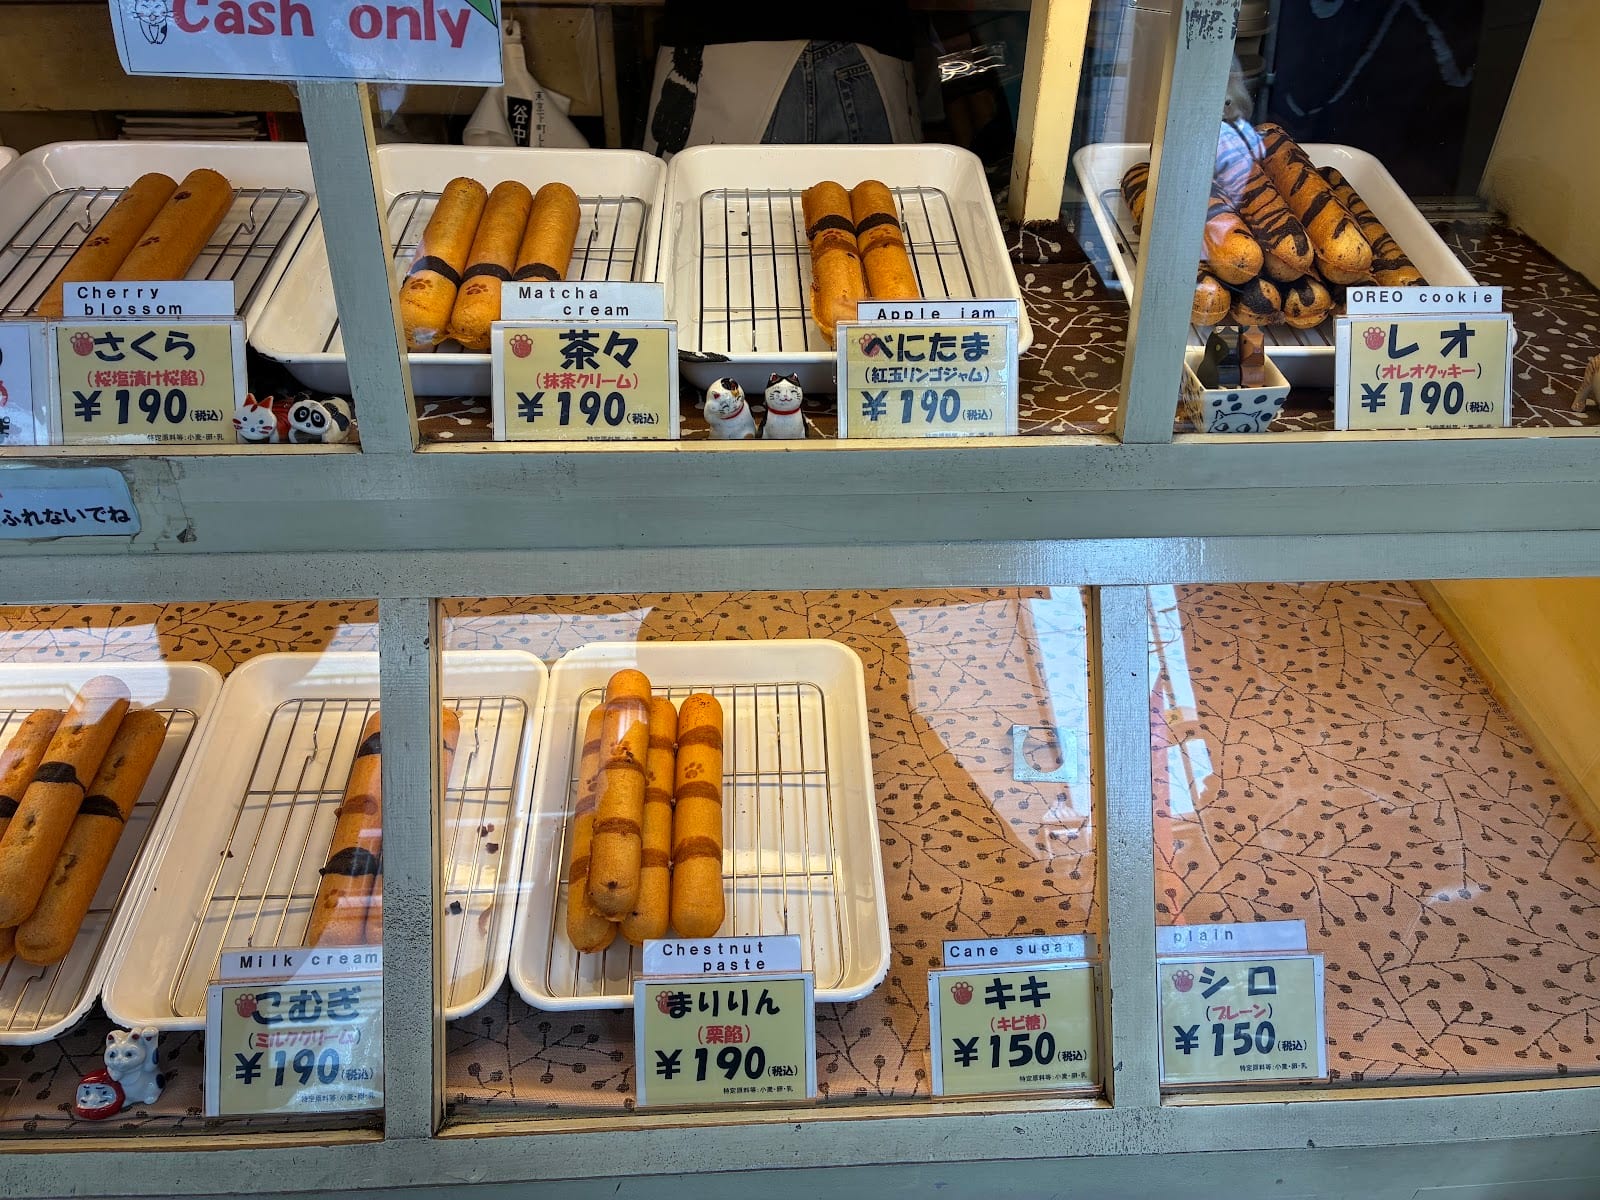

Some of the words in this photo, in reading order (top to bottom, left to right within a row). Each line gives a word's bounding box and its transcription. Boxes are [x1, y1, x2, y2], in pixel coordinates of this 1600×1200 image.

[175, 0, 314, 37] Cash
[348, 0, 471, 48] only
[512, 104, 529, 145] 谷中
[77, 286, 159, 300] Cherry
[519, 286, 598, 299] Matcha
[1352, 290, 1403, 303] OREO
[1419, 290, 1493, 303] cookie
[84, 303, 182, 316] blossom
[563, 304, 629, 316] cream
[877, 307, 940, 320] Apple
[94, 331, 195, 361] さくら
[559, 329, 639, 370] 茶々
[864, 332, 990, 362] べにたま
[1388, 322, 1475, 359] レオ
[865, 366, 990, 383] (紅玉リンゴジャム)
[1375, 362, 1482, 380] (オレオクッキー)
[536, 372, 639, 390] (抹茶クリーム)
[2, 506, 131, 526] ふれないでね
[1173, 929, 1234, 944] plain
[662, 941, 764, 956] Chestnut
[950, 945, 999, 958] Cane
[1016, 941, 1074, 955] sugar
[239, 954, 293, 969] Milk
[311, 952, 378, 966] cream
[703, 958, 765, 972] paste
[1199, 965, 1277, 999] シロ
[985, 975, 1051, 1010] キキ
[252, 985, 362, 1025] こむぎ
[667, 989, 780, 1019] まりりん
[1205, 1002, 1273, 1021] (プレーン)
[990, 1013, 1047, 1033] (キビ糖)
